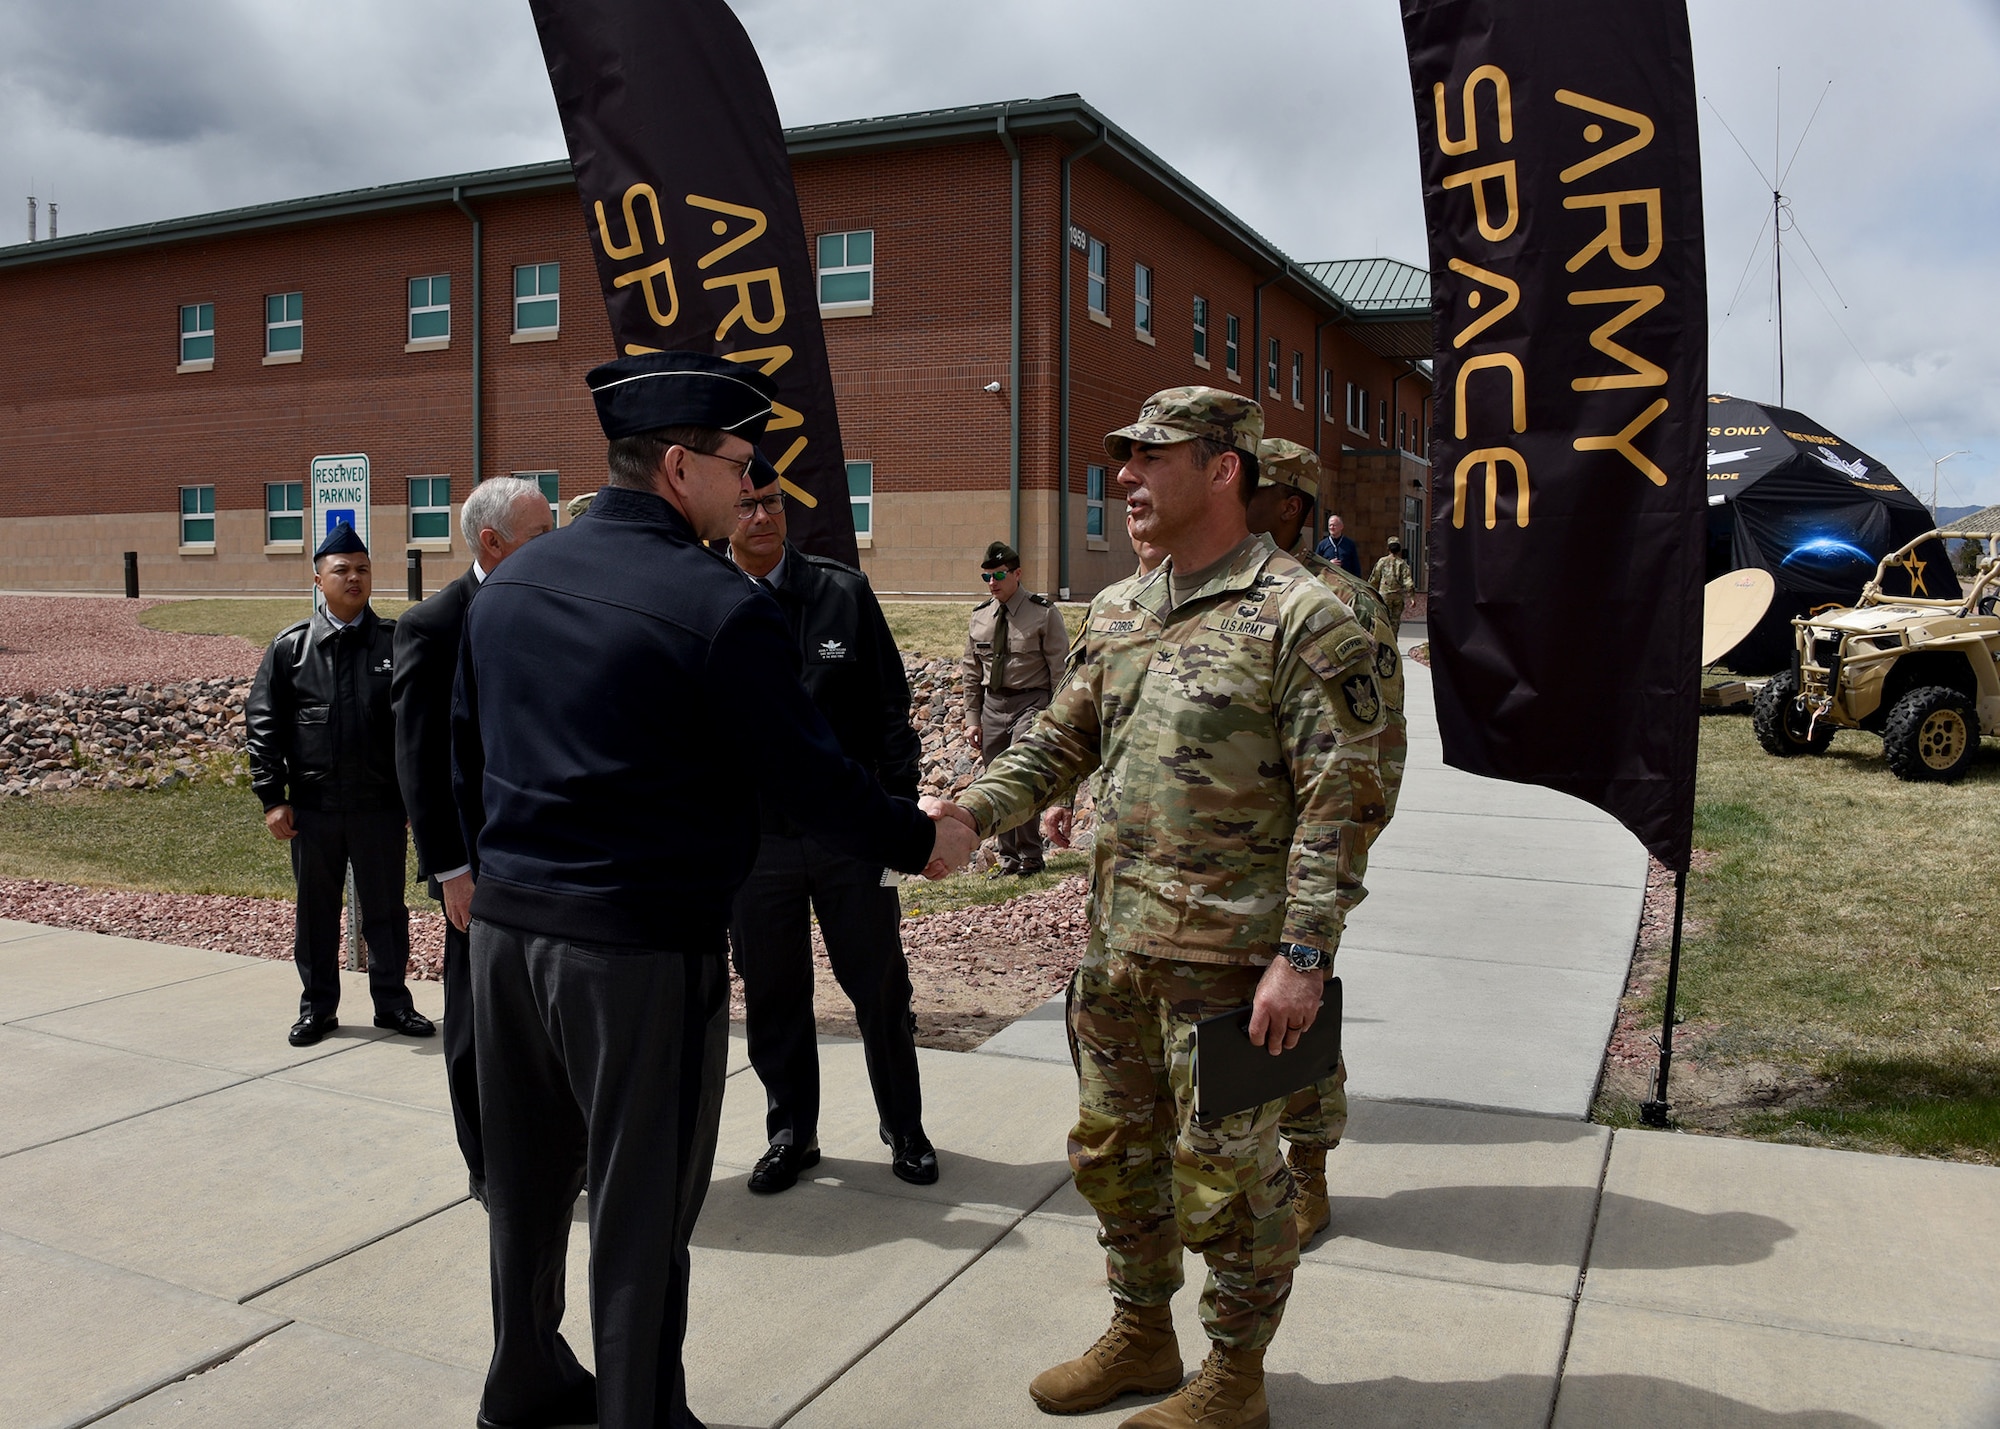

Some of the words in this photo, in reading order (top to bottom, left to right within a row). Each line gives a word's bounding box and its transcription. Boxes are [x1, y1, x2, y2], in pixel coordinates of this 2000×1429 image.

[1069, 225, 1087, 250] 1959
[1556, 90, 1668, 486] ARMY
[1434, 65, 1529, 529] SPACE
[1724, 426, 1770, 436] ONLY
[315, 466, 365, 483] RESERVED
[319, 487, 362, 503] PARKING
[1237, 621, 1266, 636] ARMY
